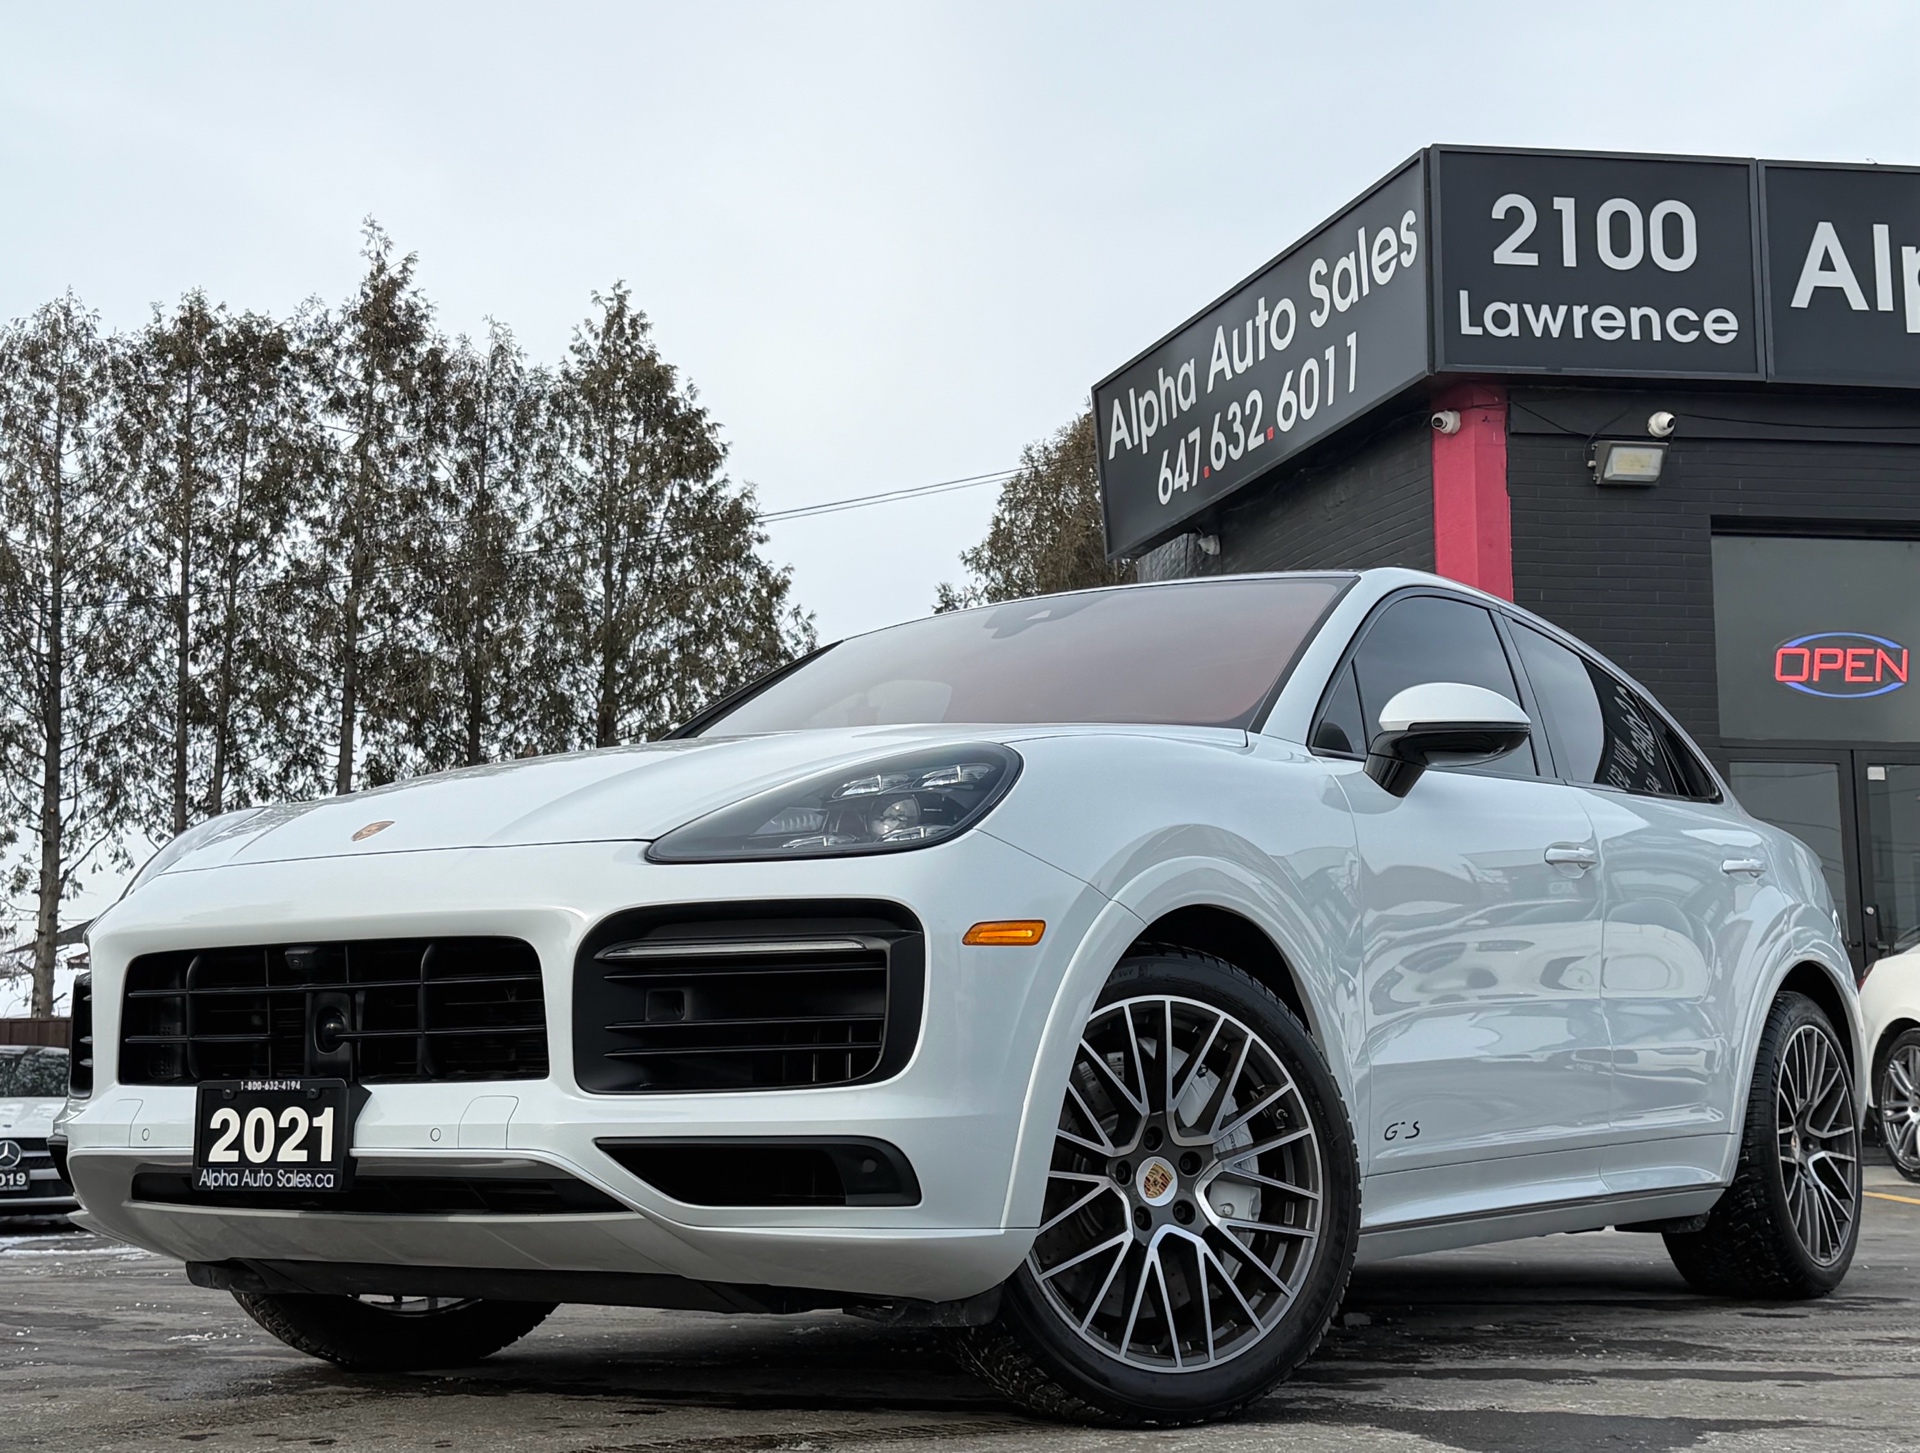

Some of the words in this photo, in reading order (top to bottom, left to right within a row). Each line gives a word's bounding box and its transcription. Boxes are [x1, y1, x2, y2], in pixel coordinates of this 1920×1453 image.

[1490, 193, 1697, 272] 2100
[1108, 358, 1196, 461] Alpha
[1207, 297, 1296, 393] Auto
[1309, 210, 1417, 328] Sales
[1459, 289, 1739, 345] Lawrence
[1158, 331, 1357, 505] 647.632.6011
[1775, 647, 1909, 683] OPEN
[208, 1106, 334, 1164] 2021
[199, 1168, 238, 1189] Alpha
[241, 1169, 273, 1187] Auto
[276, 1169, 334, 1188] Sales.ca
